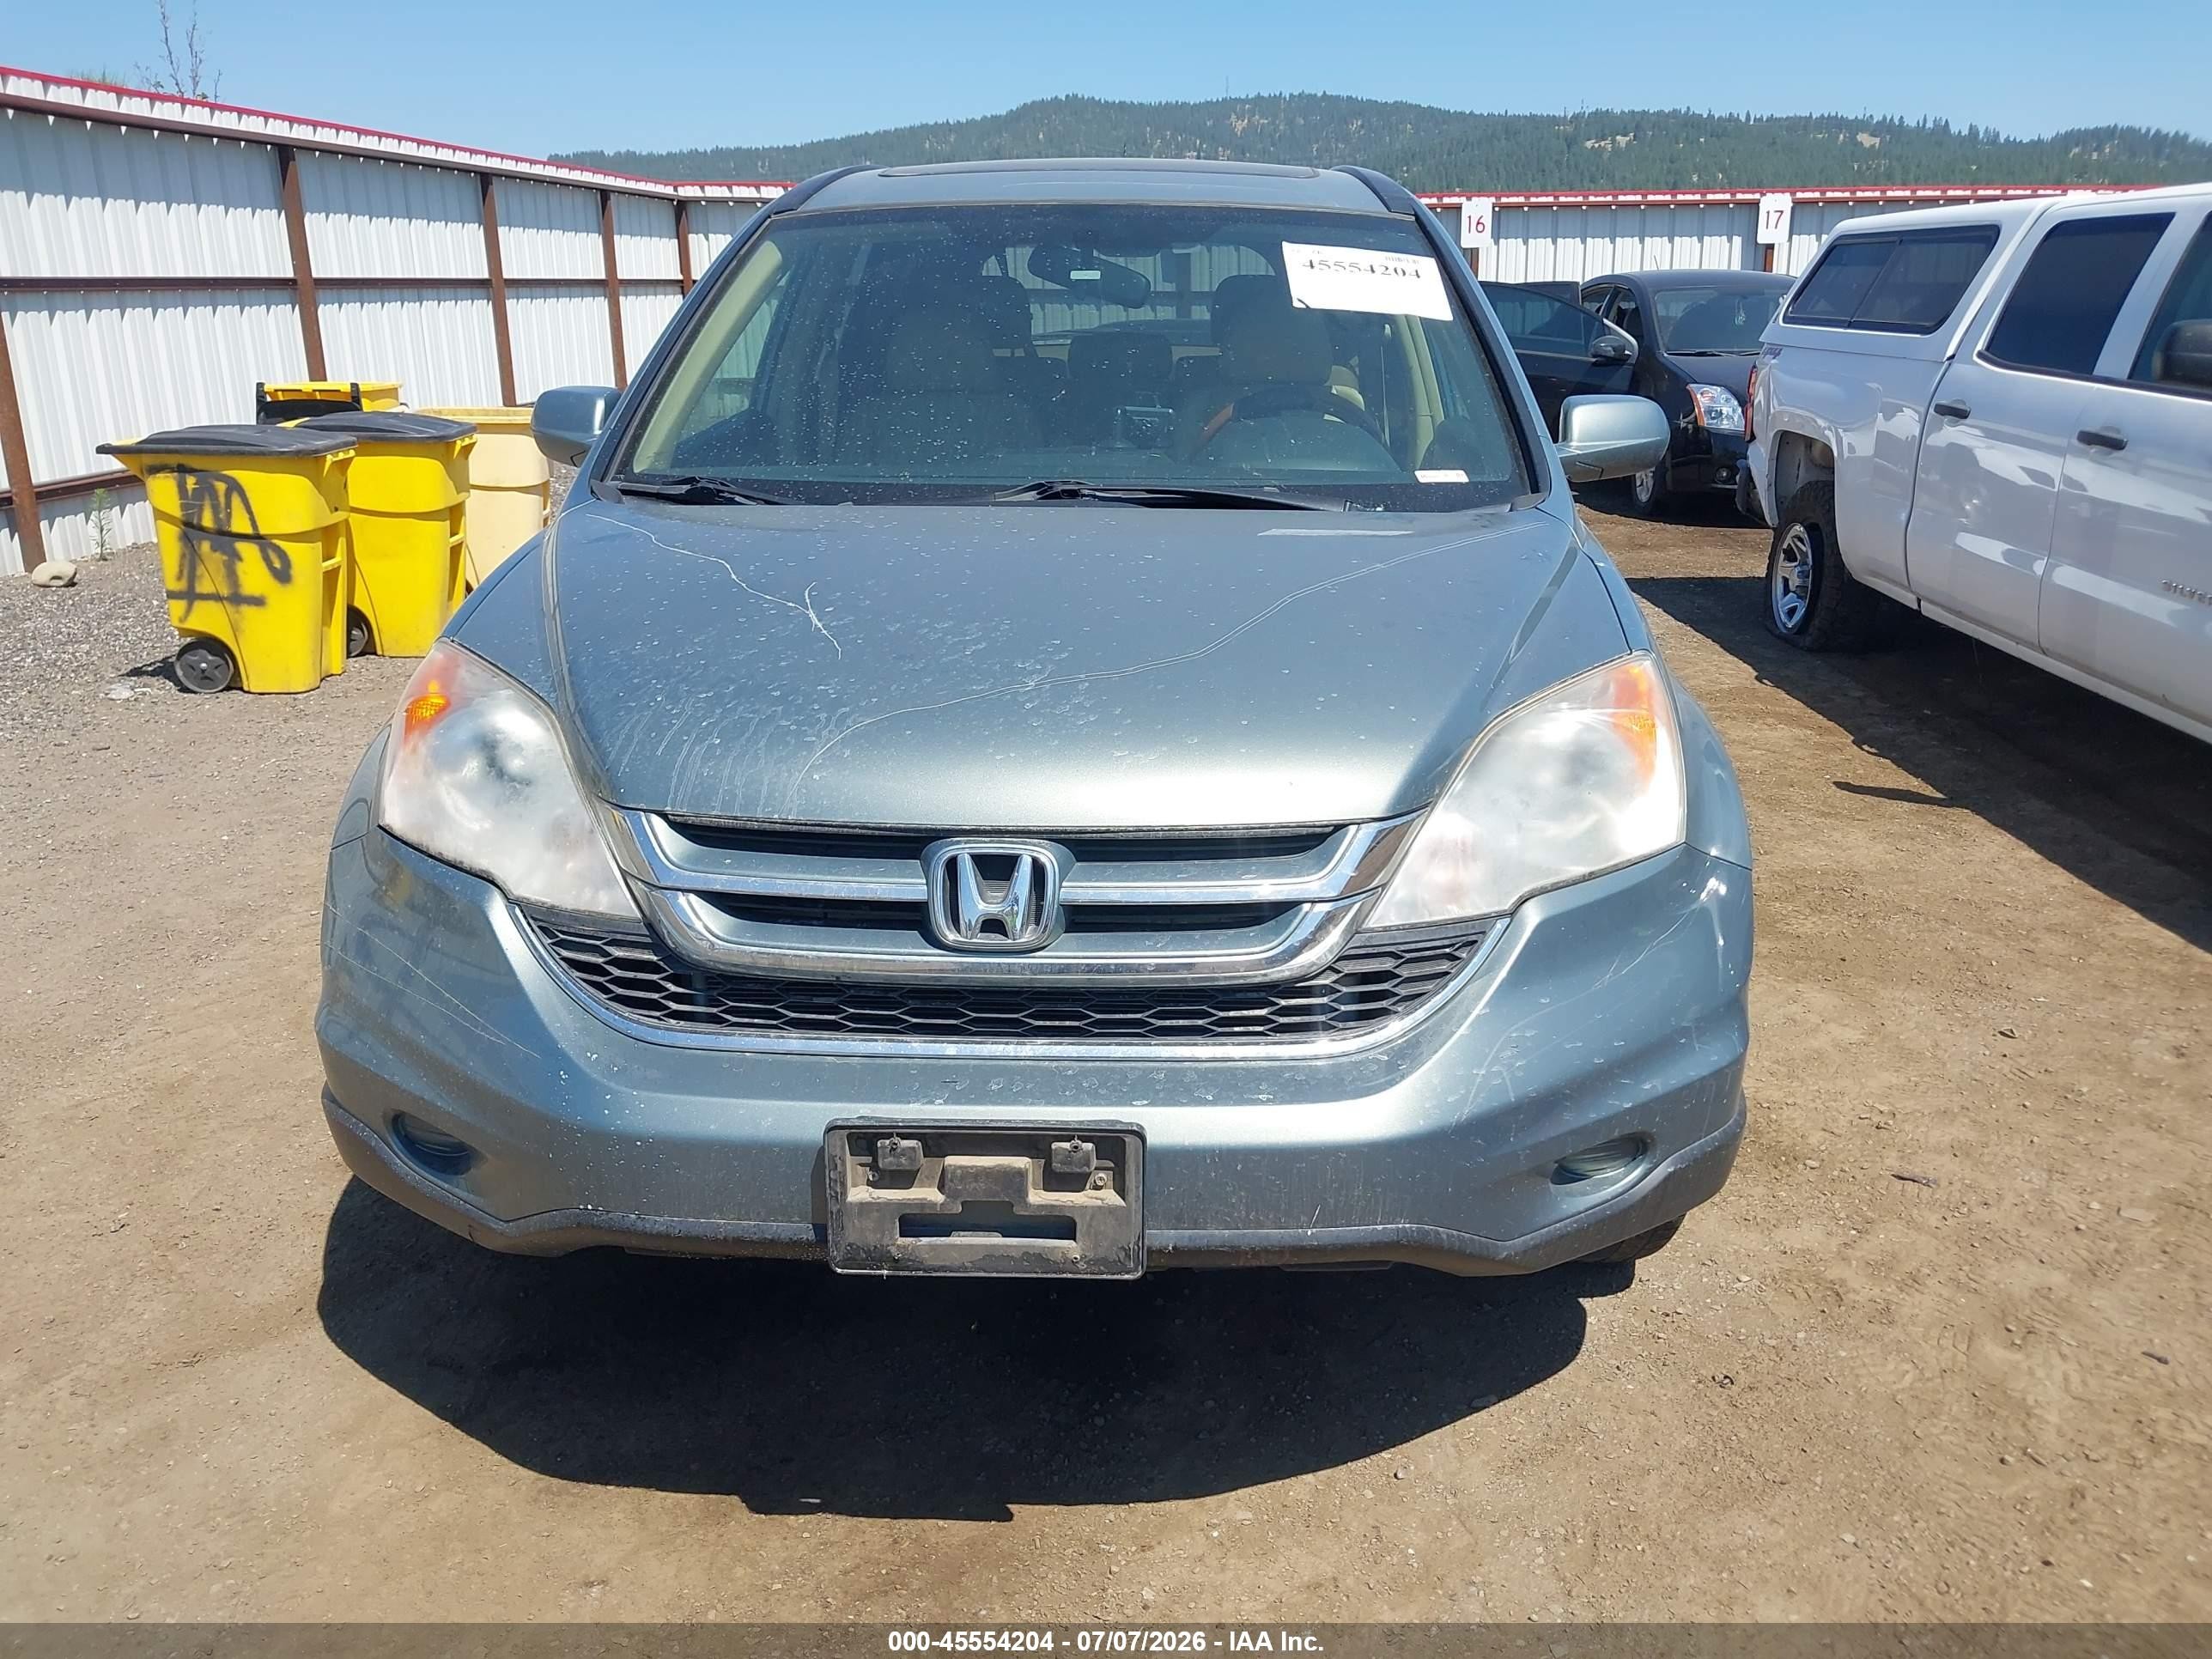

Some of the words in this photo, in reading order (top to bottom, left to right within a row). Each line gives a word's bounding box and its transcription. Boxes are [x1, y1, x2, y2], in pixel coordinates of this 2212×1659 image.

[1467, 214, 1486, 234] 16
[1765, 210, 1784, 230] 17
[1302, 258, 1421, 279] 45554204
